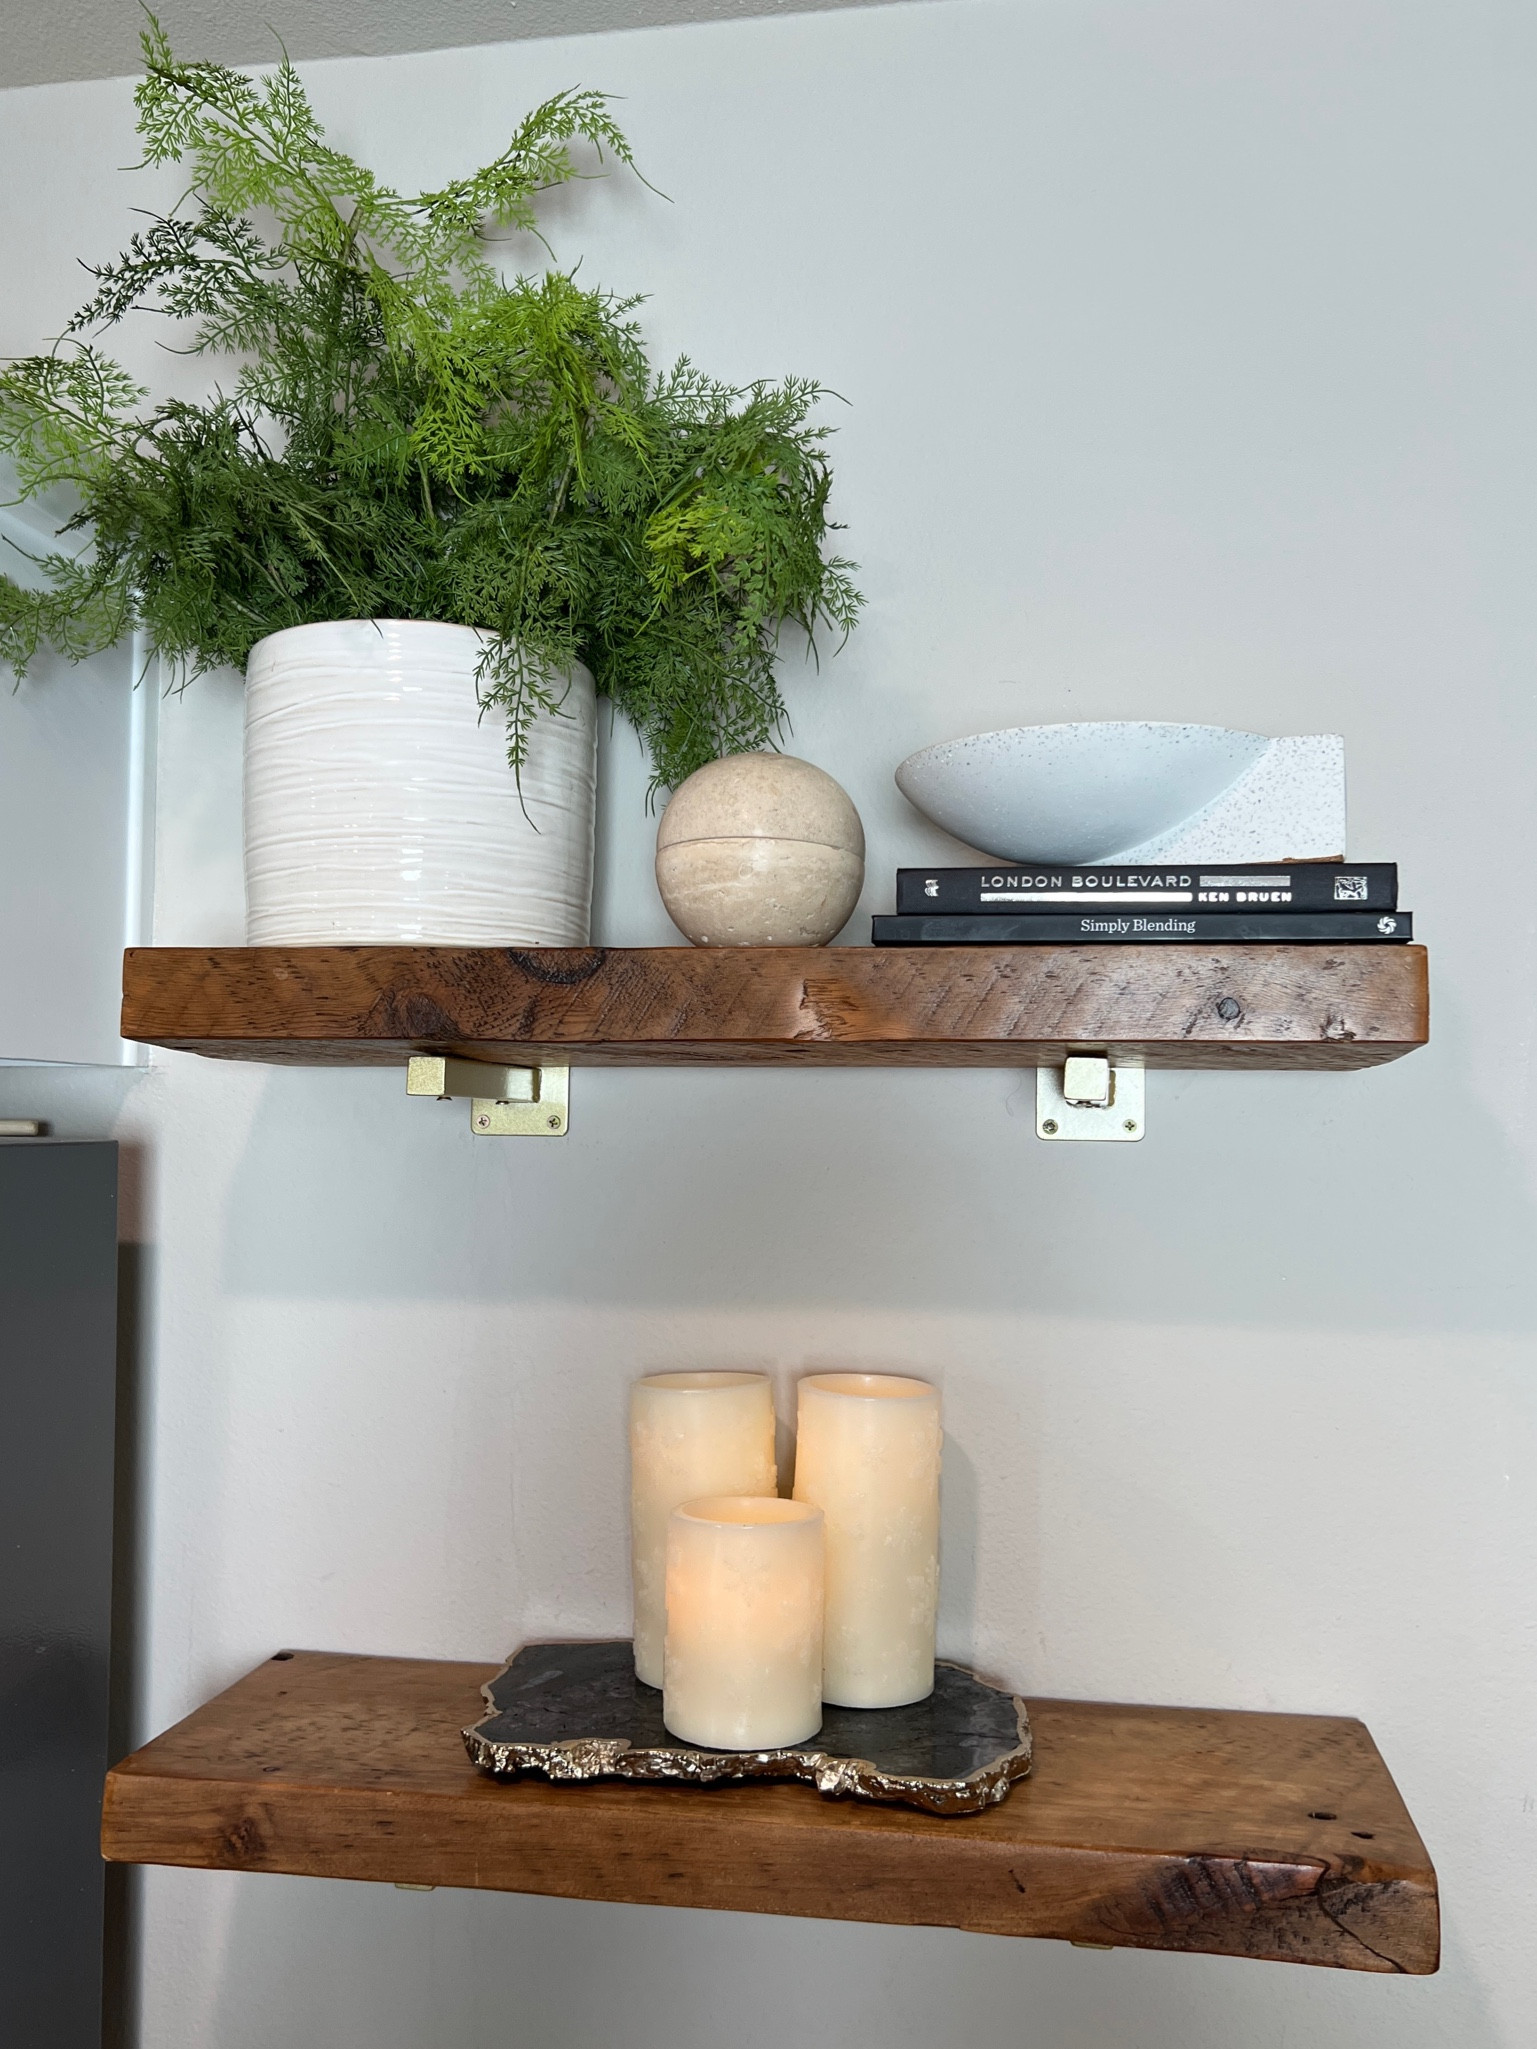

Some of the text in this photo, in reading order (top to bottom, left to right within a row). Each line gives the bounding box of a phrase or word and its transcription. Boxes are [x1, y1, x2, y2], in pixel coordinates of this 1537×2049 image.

[981, 875, 1192, 888] LONDON BOULEVARD
[1198, 891, 1292, 902] KEN BRUEN
[1080, 919, 1197, 934] Simply Blending
